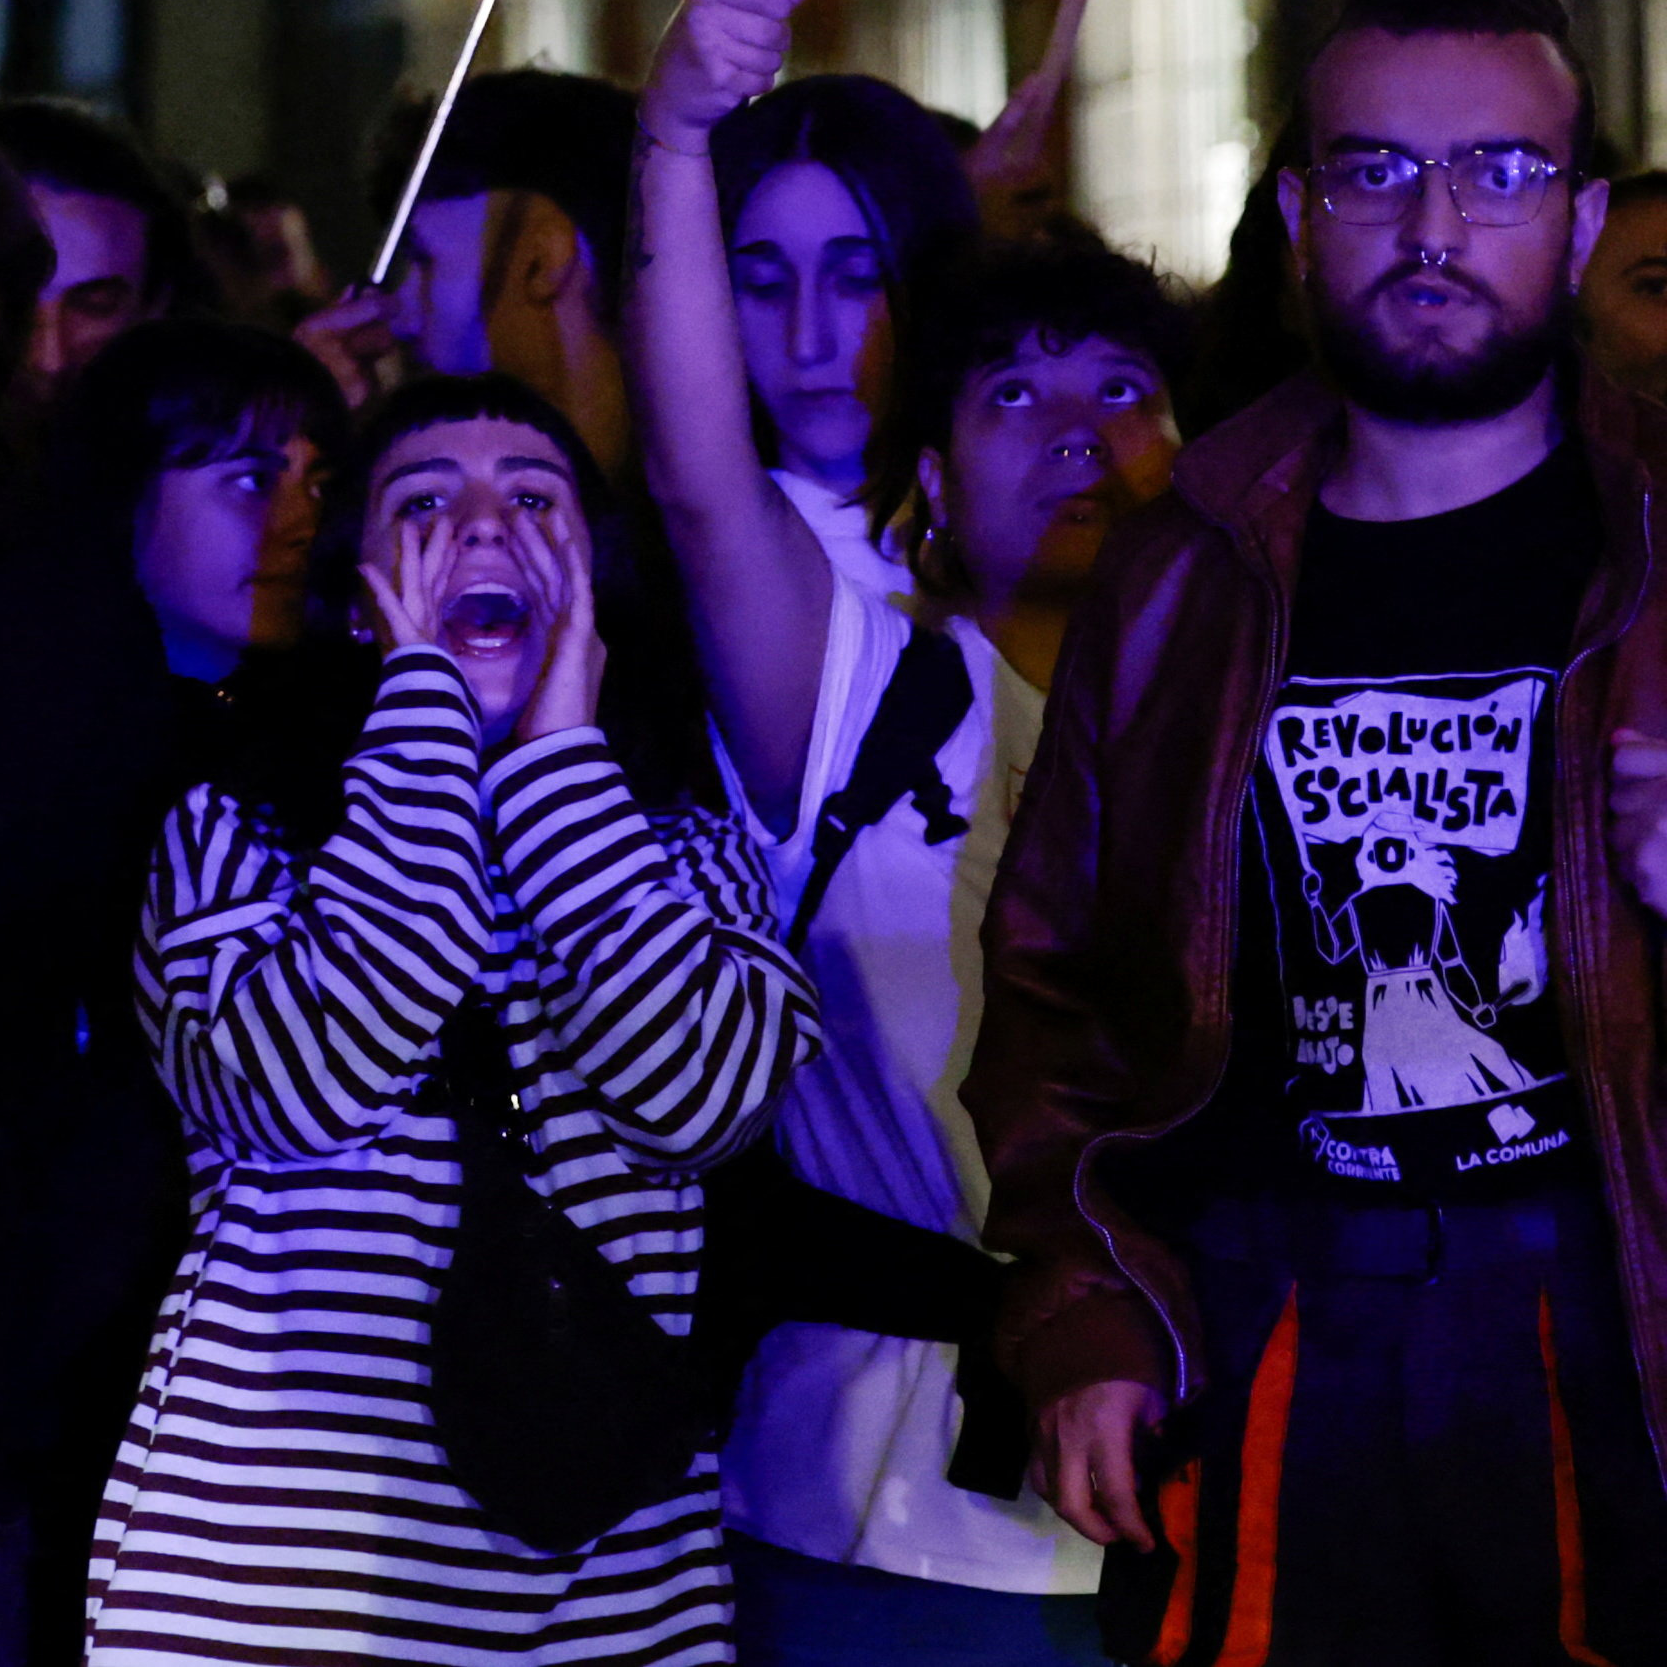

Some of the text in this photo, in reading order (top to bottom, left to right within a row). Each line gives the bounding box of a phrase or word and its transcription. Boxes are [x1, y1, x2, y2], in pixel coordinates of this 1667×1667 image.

[1277, 700, 1522, 768] REVOLUCIÓN
[1293, 765, 1517, 832] SOCIALISTA
[1456, 1128, 1571, 1171] LA COMUNA
